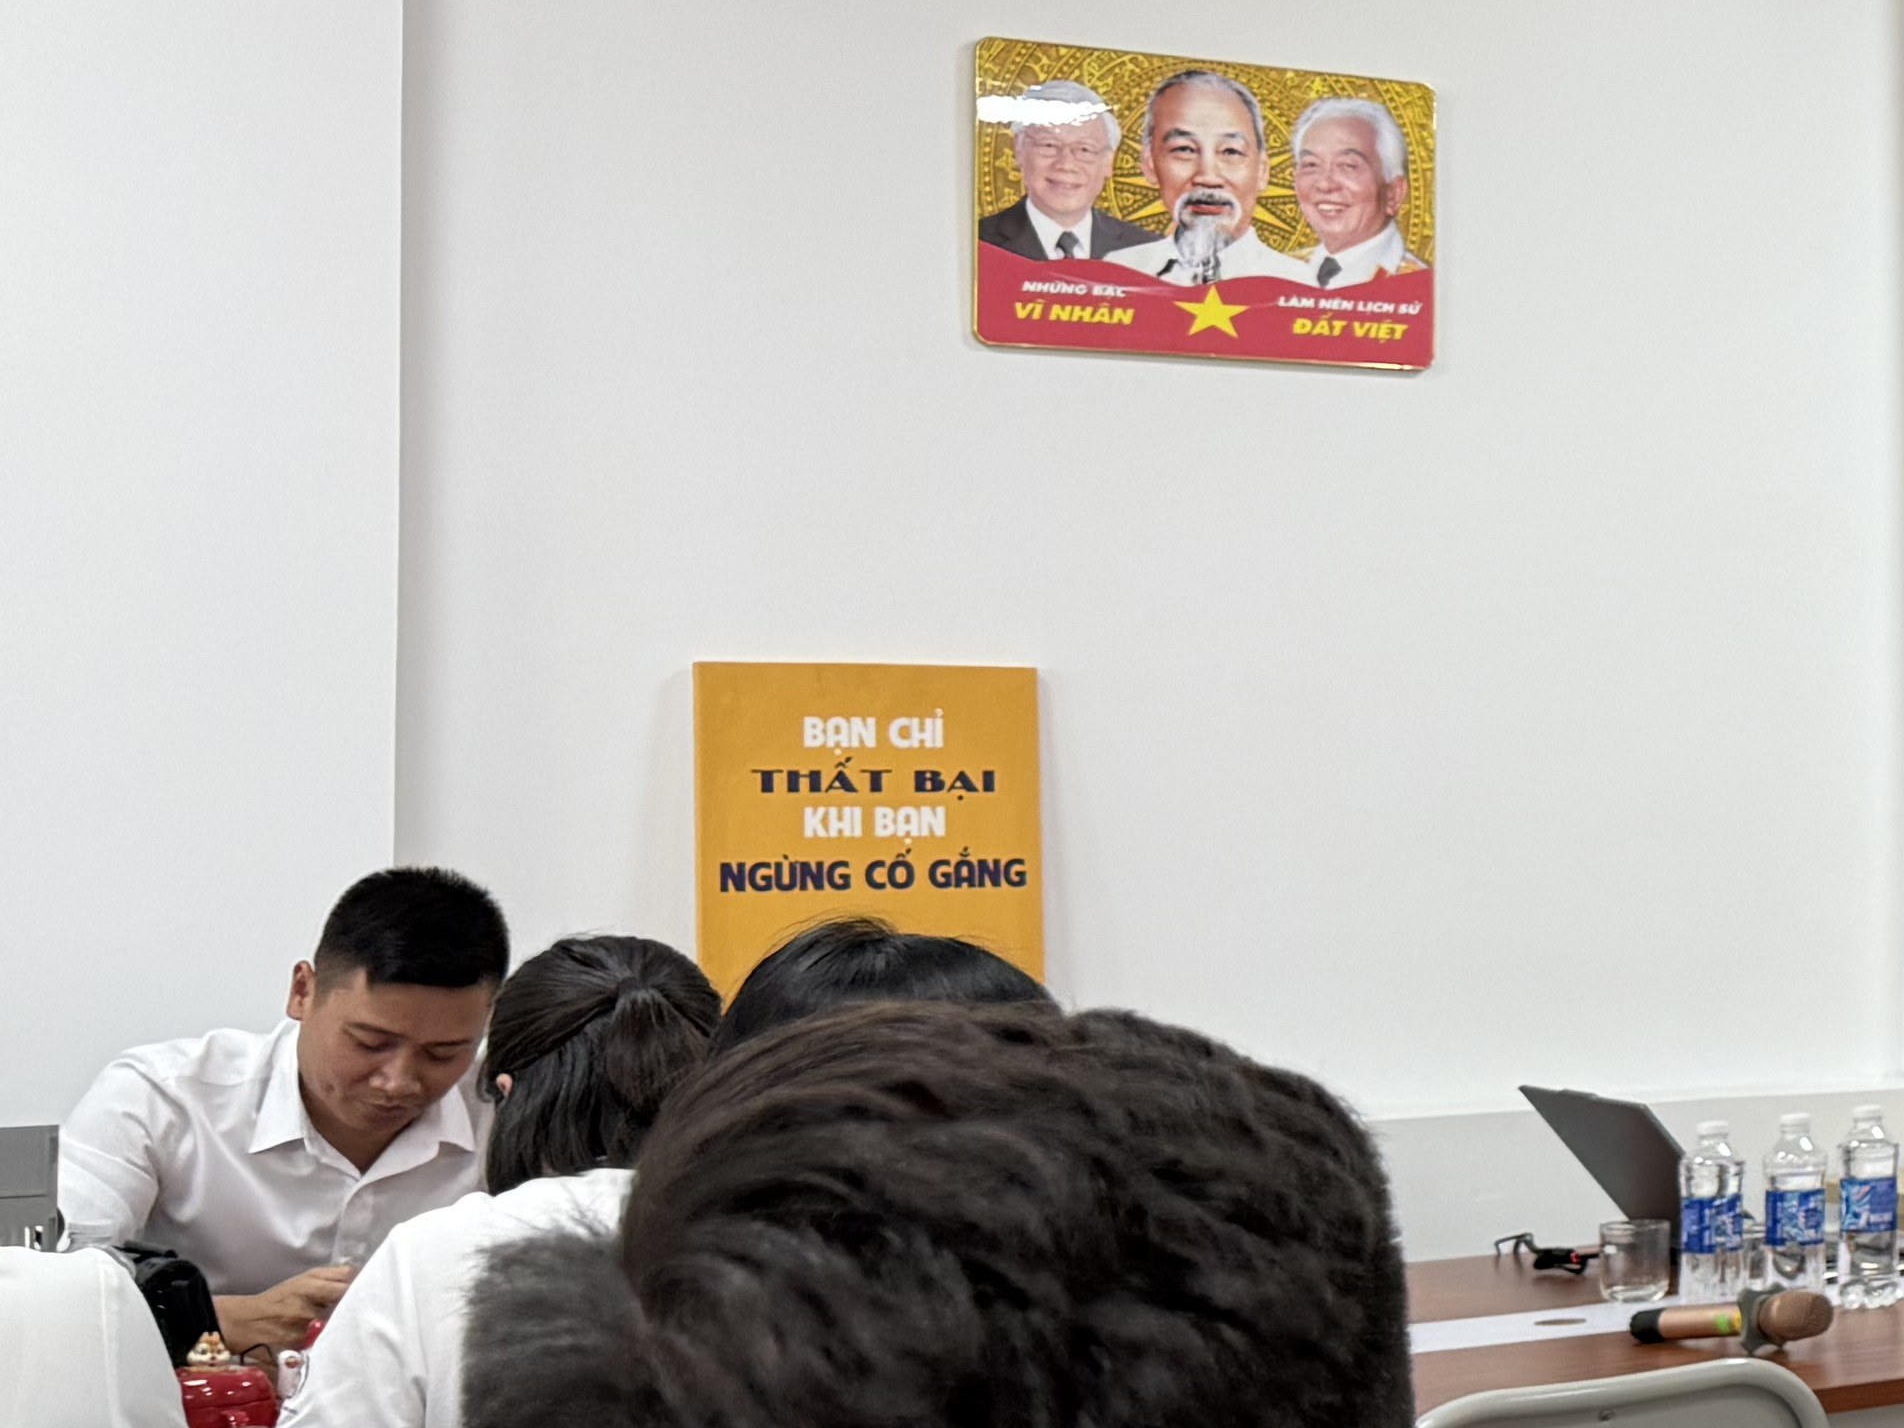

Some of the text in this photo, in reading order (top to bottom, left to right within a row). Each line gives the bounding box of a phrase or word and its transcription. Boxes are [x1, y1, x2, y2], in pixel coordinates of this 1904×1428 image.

[1014, 297, 1135, 325] VĨ NHÂN
[1292, 311, 1408, 344] ĐẤT VIỆT
[803, 707, 944, 756] BẠN CHỈ
[750, 756, 996, 801] THẤT BẠI
[804, 805, 946, 845] KHI BẠN
[865, 847, 915, 890] CỐ
[928, 845, 1027, 888] GẮNG
